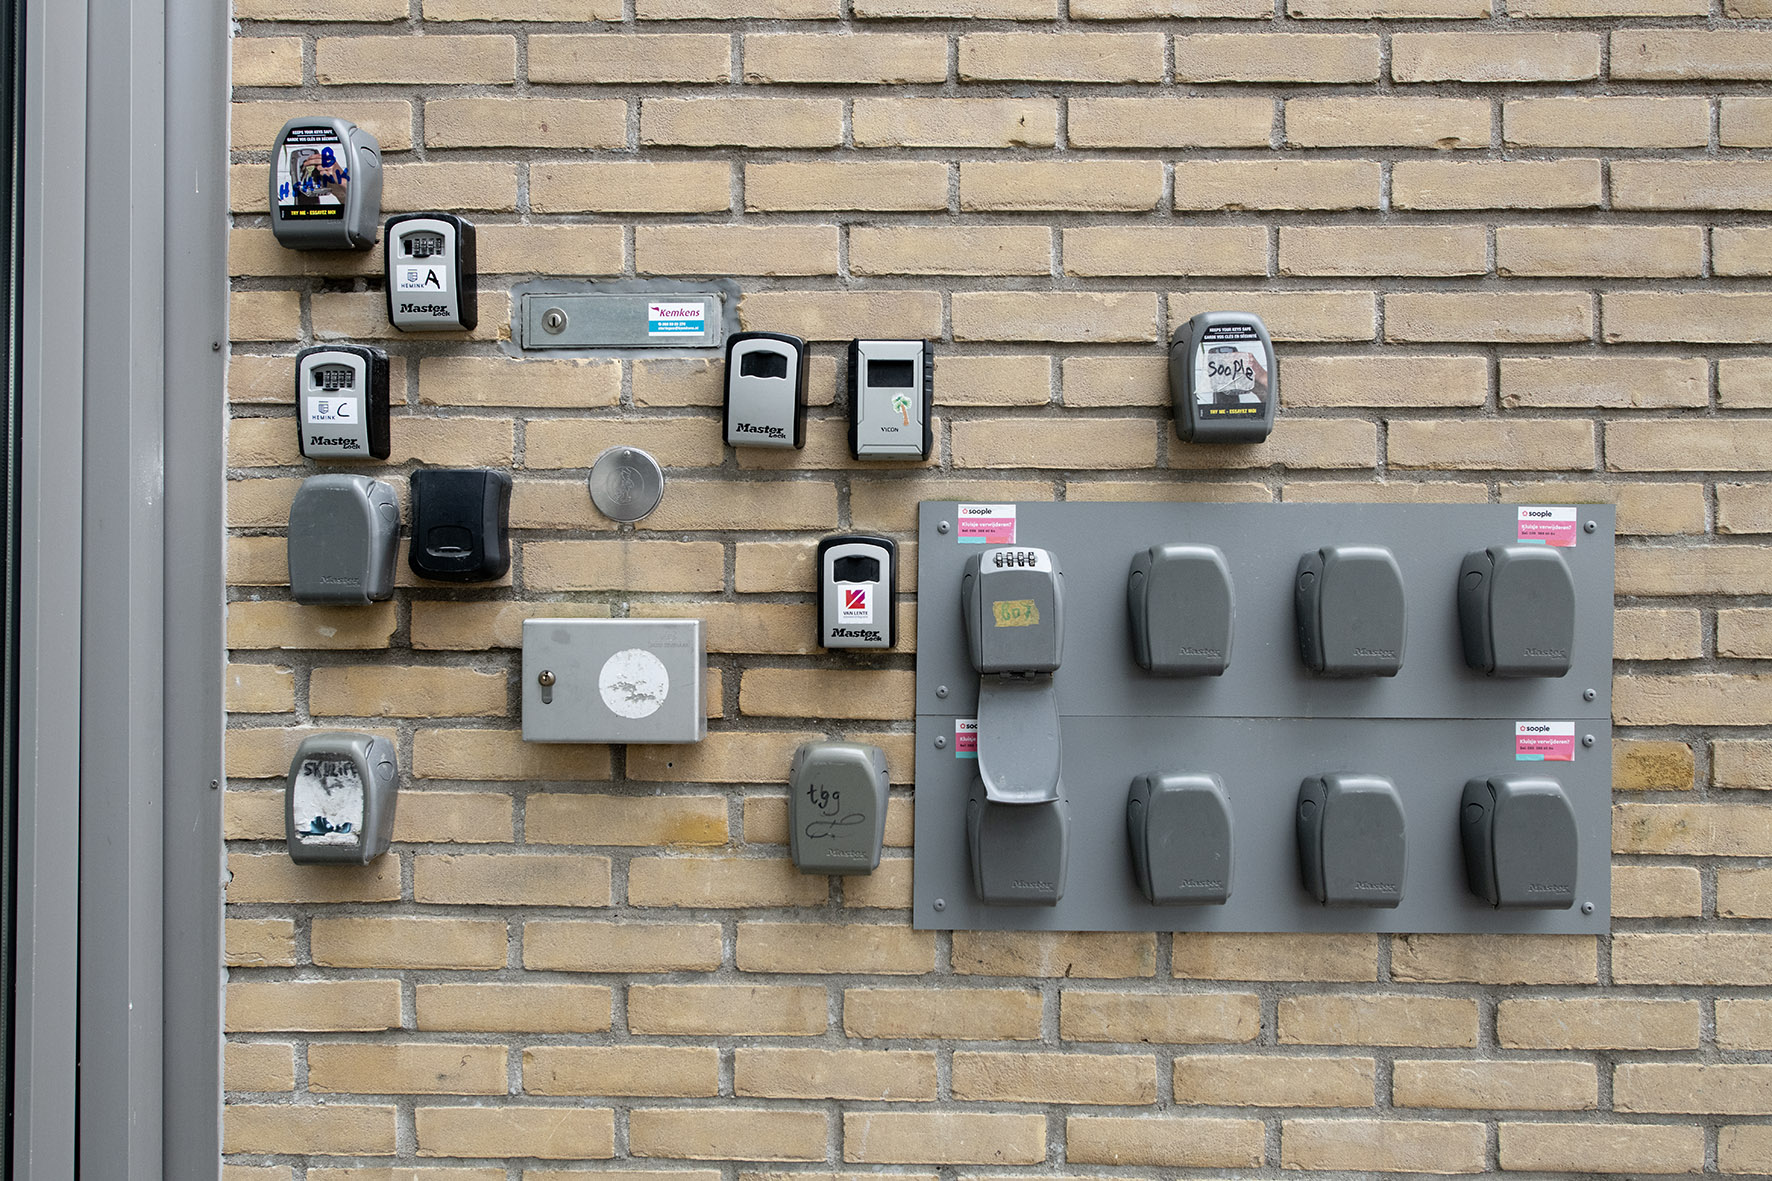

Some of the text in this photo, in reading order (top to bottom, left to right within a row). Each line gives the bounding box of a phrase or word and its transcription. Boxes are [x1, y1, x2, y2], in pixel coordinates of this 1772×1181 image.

[321, 146, 336, 168] B
[425, 268, 441, 290] A
[399, 303, 448, 313] Master
[659, 308, 700, 317] Kemkens
[336, 402, 350, 418] C
[735, 422, 784, 435] Master
[310, 436, 358, 446] Master
[968, 507, 993, 516] soople
[1528, 510, 1553, 518] soople
[831, 628, 880, 638] Master
[1526, 725, 1551, 733] soople
